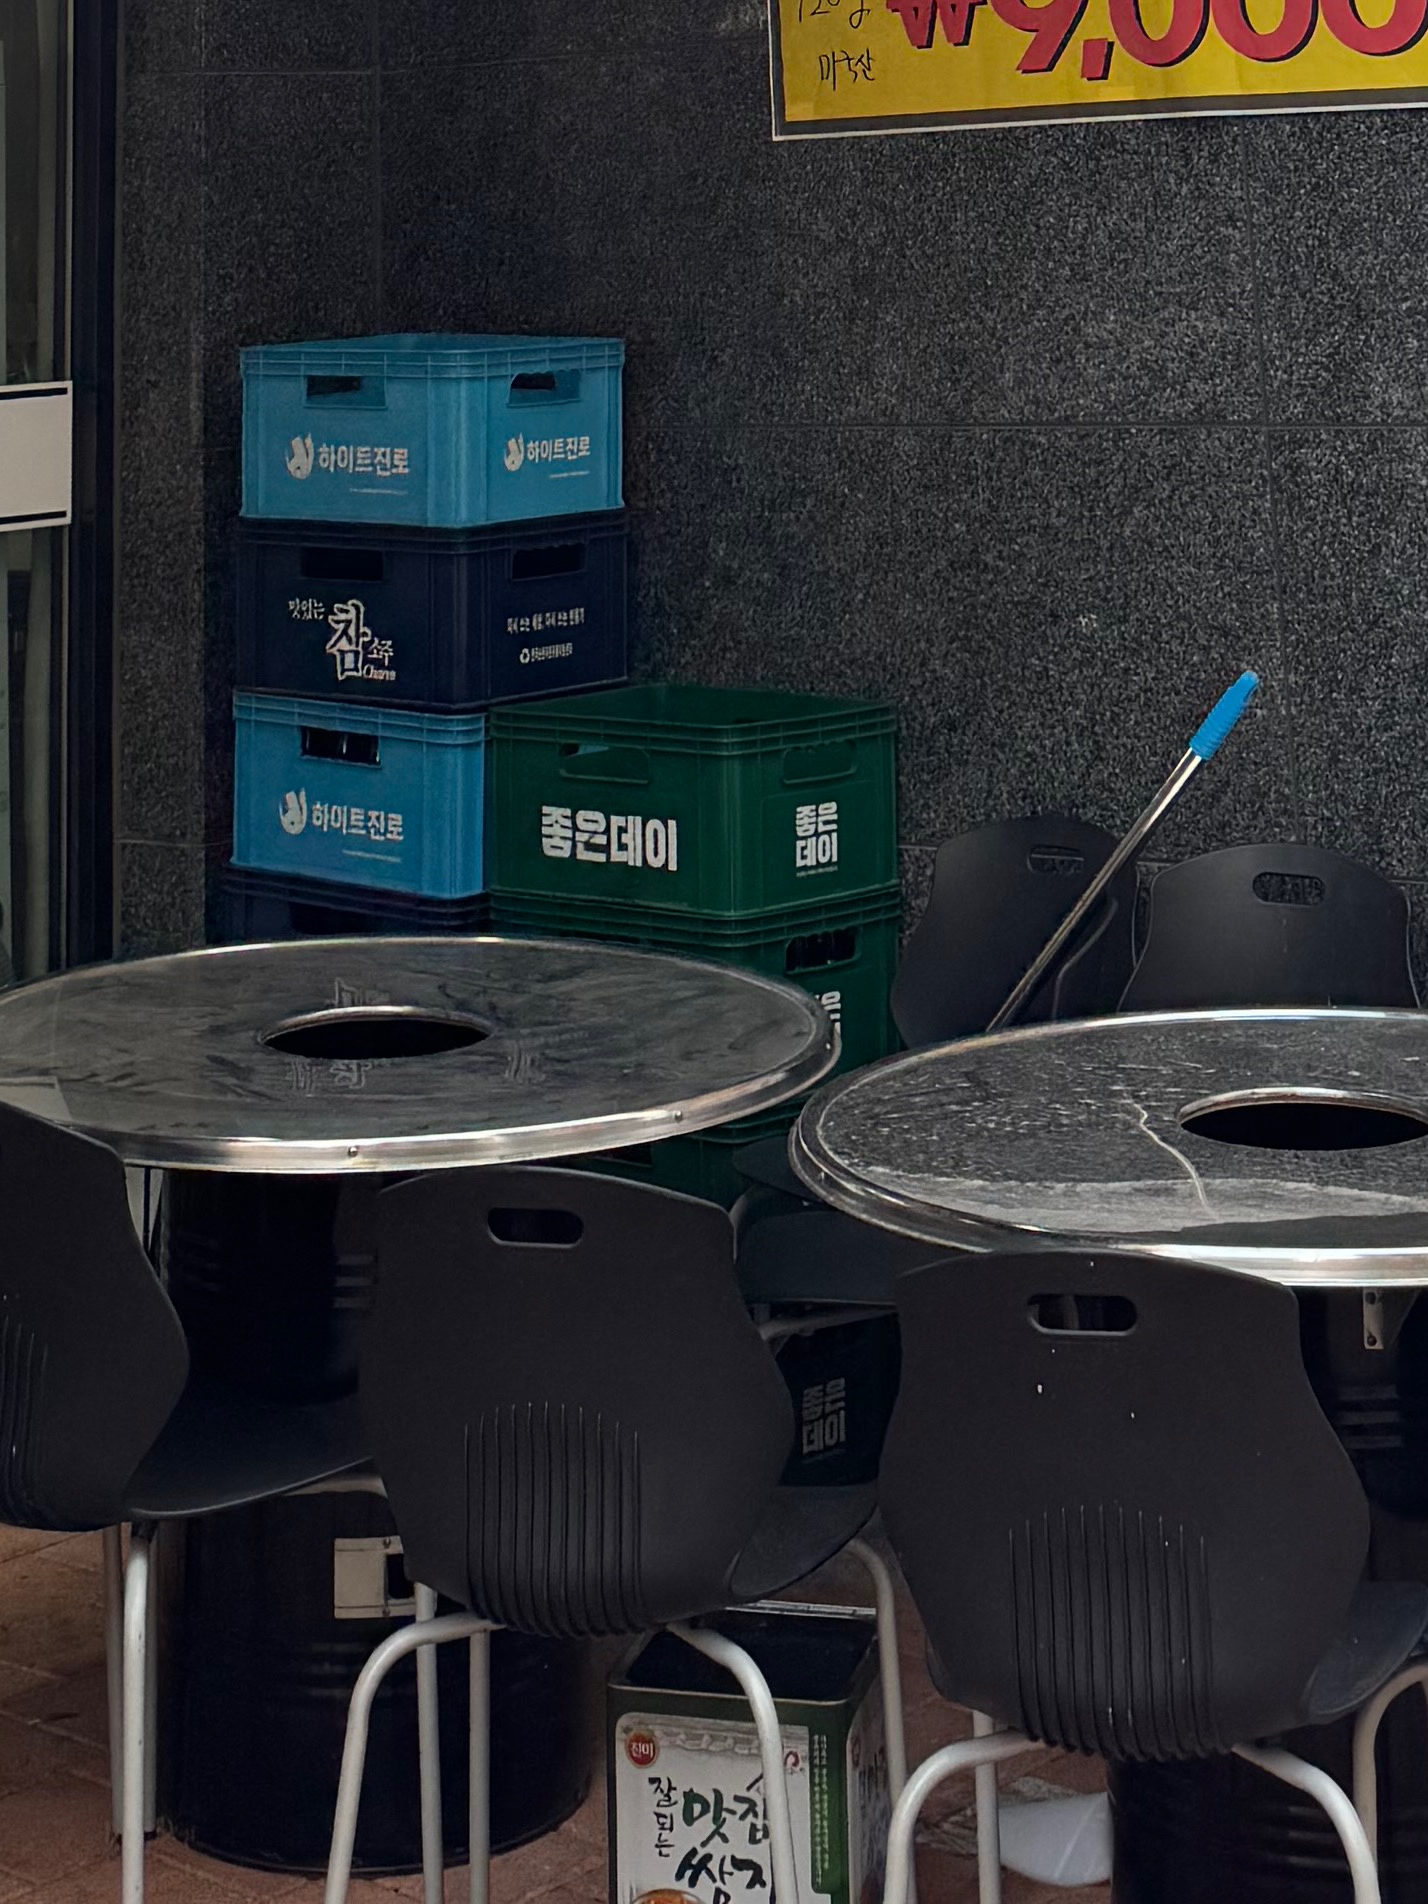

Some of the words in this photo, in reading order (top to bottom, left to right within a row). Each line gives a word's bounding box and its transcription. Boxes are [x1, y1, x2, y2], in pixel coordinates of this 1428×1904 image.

[318, 442, 410, 477] 하이트진로
[527, 434, 591, 463] 하이트진로
[367, 637, 395, 667] 소주
[310, 798, 404, 843] 하이트진로
[795, 801, 839, 838] 좋은
[541, 805, 679, 872] 좋은데이
[795, 832, 839, 868] 데이
[802, 1376, 846, 1422] 좋은
[802, 1409, 846, 1455] 데이
